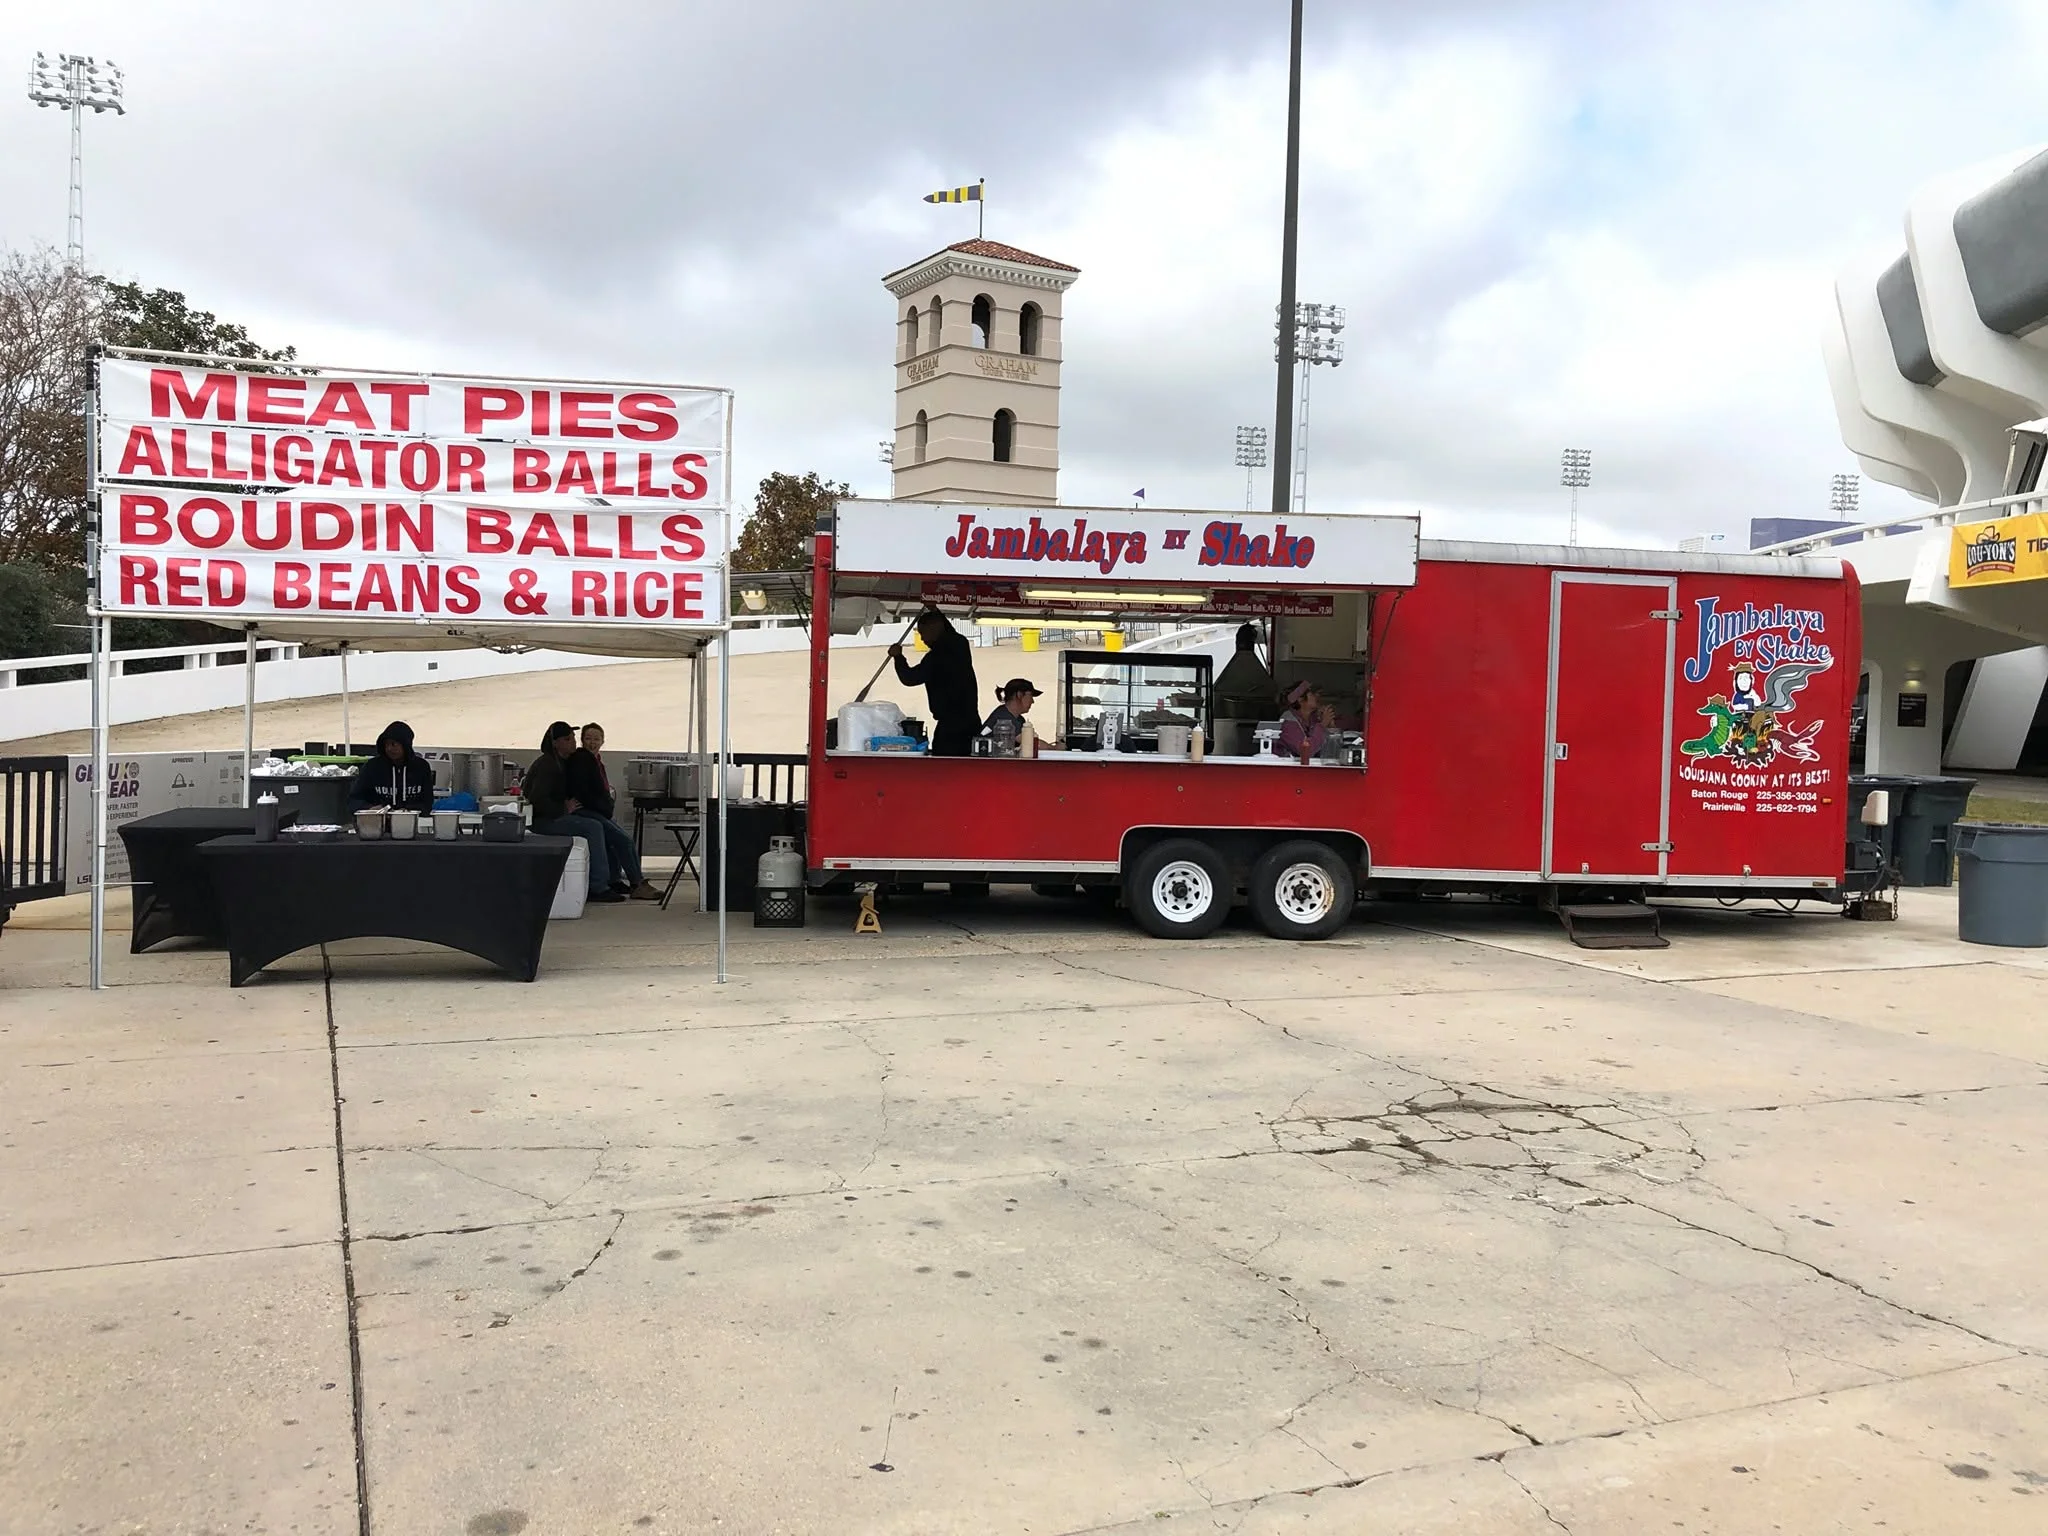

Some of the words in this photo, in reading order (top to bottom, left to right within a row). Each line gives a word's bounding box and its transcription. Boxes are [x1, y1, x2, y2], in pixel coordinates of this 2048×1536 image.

[907, 354, 939, 377] GRAHAM
[975, 355, 1038, 375] GRAHAM
[149, 368, 430, 432] MEAT
[463, 386, 679, 442] PIES
[118, 425, 486, 493] ALLIGATOR
[512, 448, 709, 501] BALLS
[119, 493, 434, 554] BOUDIN
[466, 508, 705, 562] BALLS
[945, 514, 1148, 575] Jambalaya
[1198, 521, 1315, 569] Shake
[118, 554, 247, 608] RED
[273, 560, 481, 616] BEANS
[503, 567, 549, 616] &
[570, 569, 704, 620] RICE
[977, 595, 1005, 606] Hamburger
[1684, 596, 1825, 682] Jambalaya
[1735, 639, 1754, 658] BY
[1756, 634, 1832, 673] Shake
[1679, 765, 1727, 786] LOUISIANA
[1731, 773, 1768, 788] COOKIN'
[1772, 773, 1785, 788] AT
[1788, 773, 1801, 787] ITS
[1805, 769, 1830, 786] BEST!
[1691, 789, 1717, 799] Baton
[1721, 789, 1748, 801] Rouge
[1756, 791, 1817, 801] 225-356-3034
[1702, 802, 1746, 812] Prairieville
[1756, 803, 1817, 813] 225-622-1794
